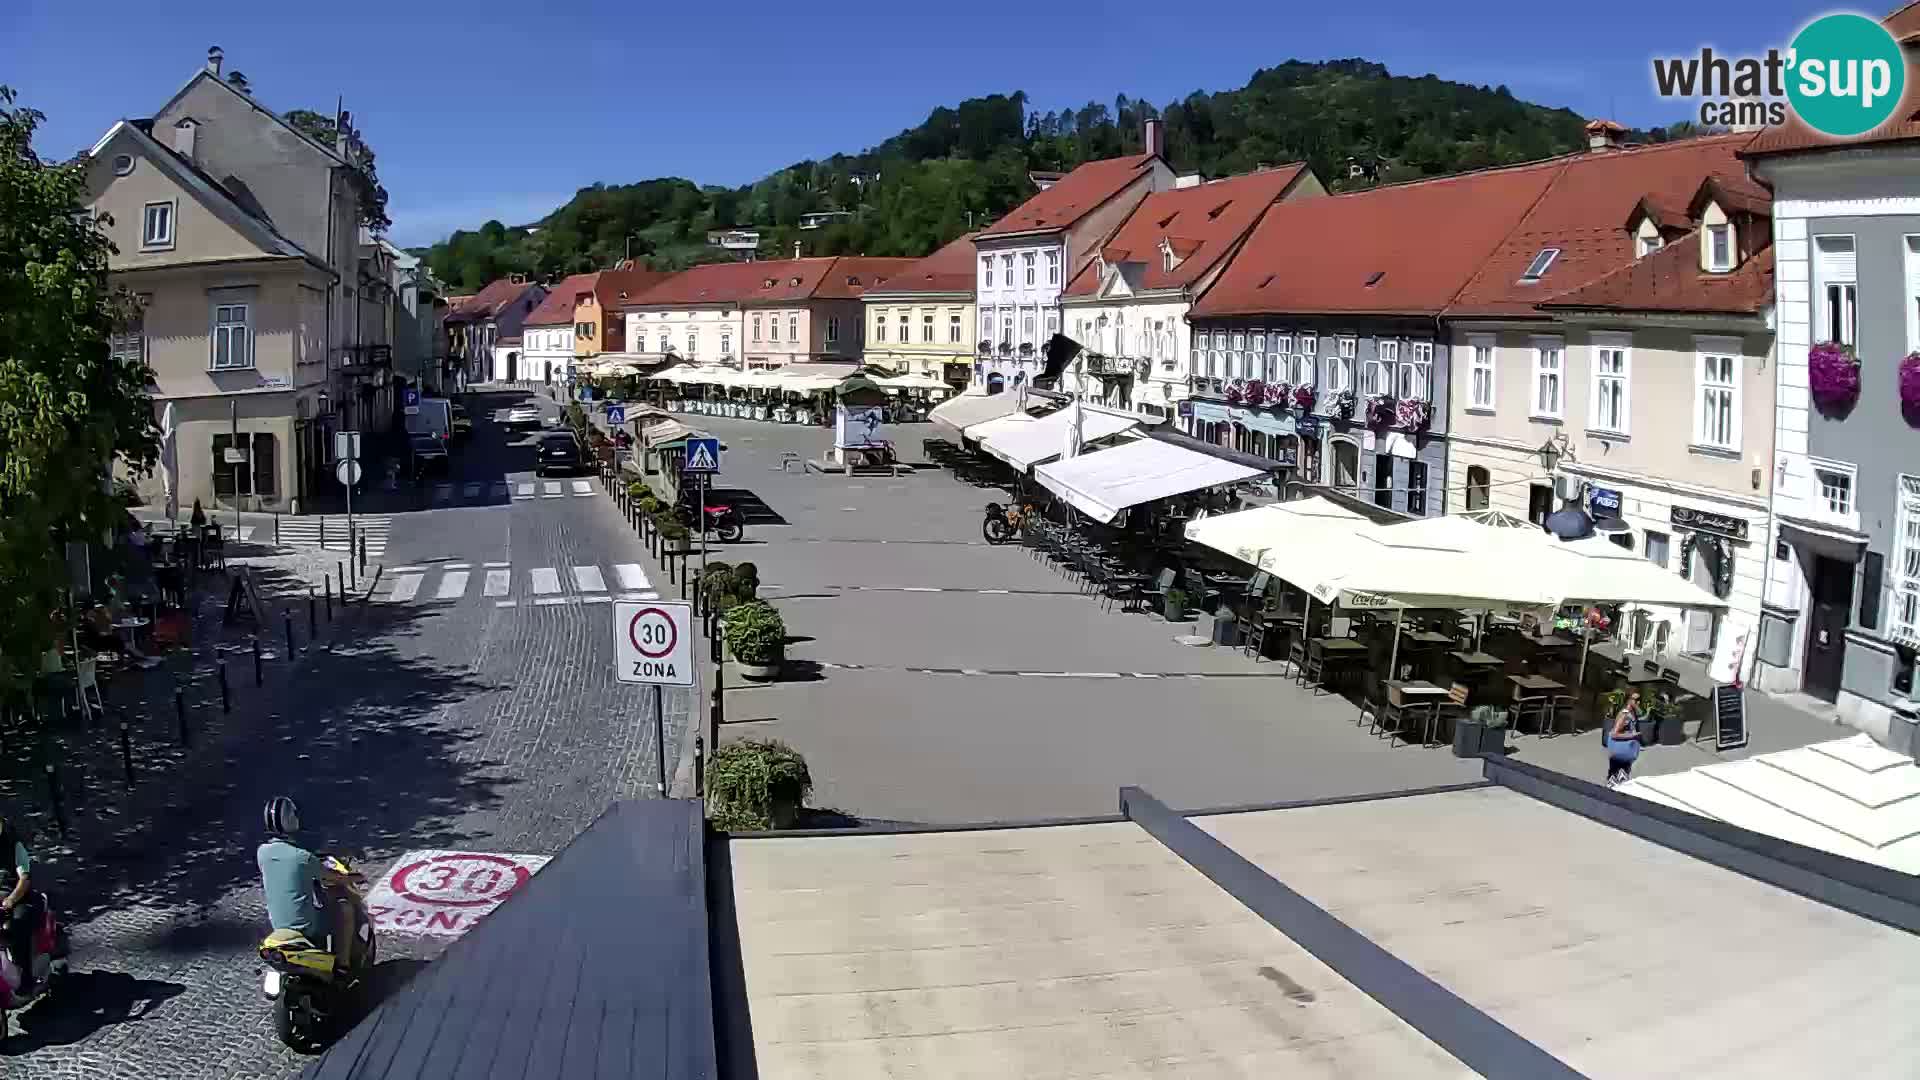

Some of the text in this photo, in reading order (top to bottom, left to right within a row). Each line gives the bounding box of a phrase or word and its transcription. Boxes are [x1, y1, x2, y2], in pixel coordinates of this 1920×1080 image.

[642, 623, 666, 645] 30
[633, 661, 676, 678] ZONA
[418, 866, 503, 894] 30
